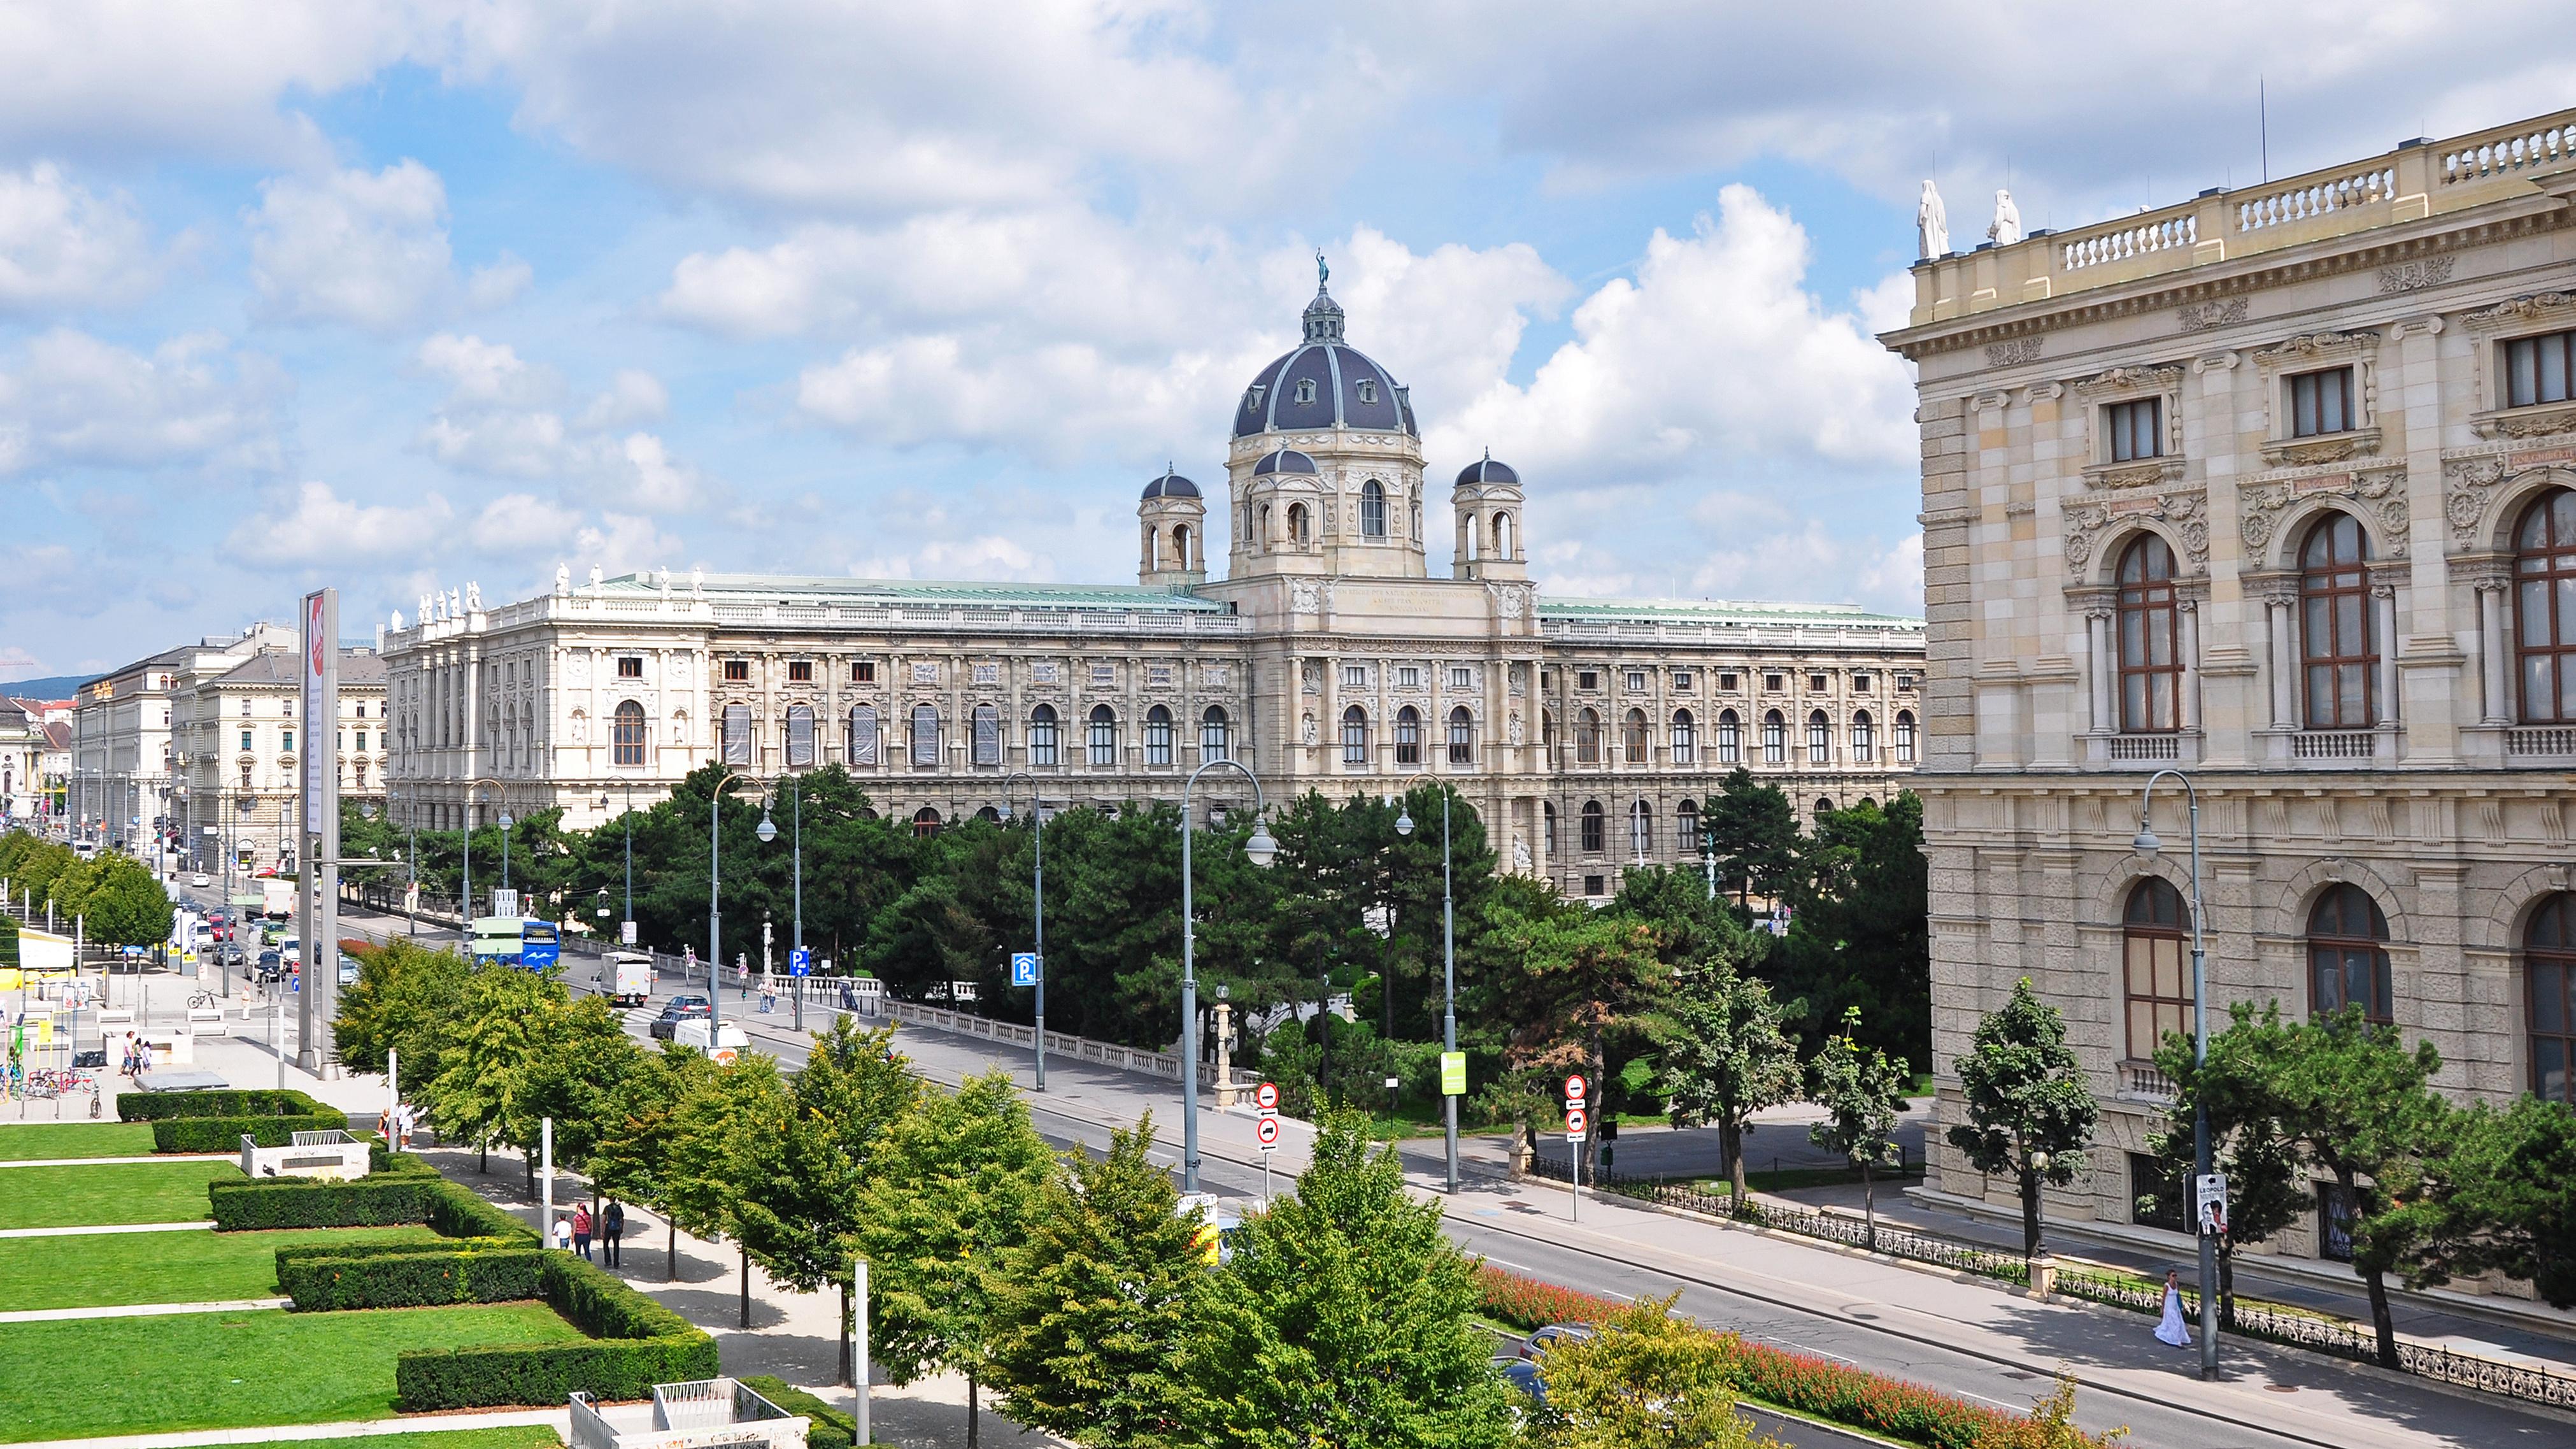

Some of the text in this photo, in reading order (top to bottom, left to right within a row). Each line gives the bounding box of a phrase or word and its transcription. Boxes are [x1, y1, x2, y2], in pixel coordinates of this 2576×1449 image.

[793, 952, 802, 967] P
[1020, 962, 1029, 980] P
[1179, 1196, 1216, 1205] KUNST
